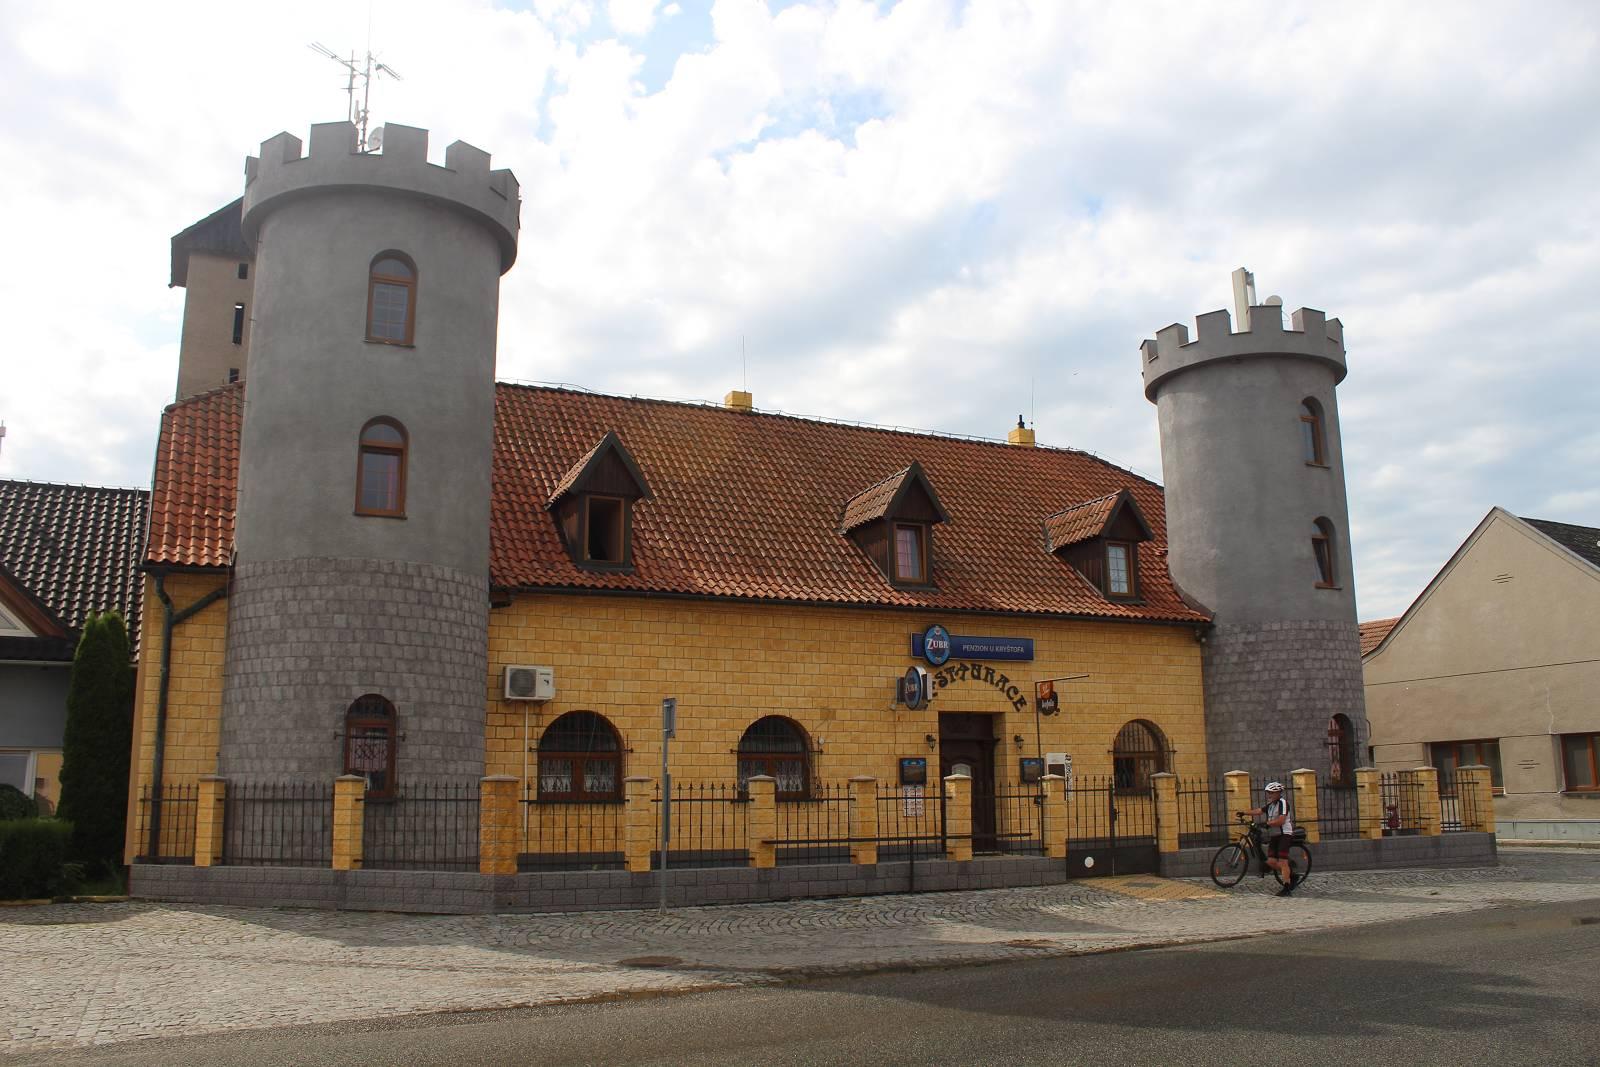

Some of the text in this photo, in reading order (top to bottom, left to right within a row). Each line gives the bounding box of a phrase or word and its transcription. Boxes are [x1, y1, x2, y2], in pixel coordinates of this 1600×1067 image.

[926, 638, 949, 650] ZUBR
[962, 644, 988, 652] PENZION
[925, 662, 1027, 712] STAURACE
